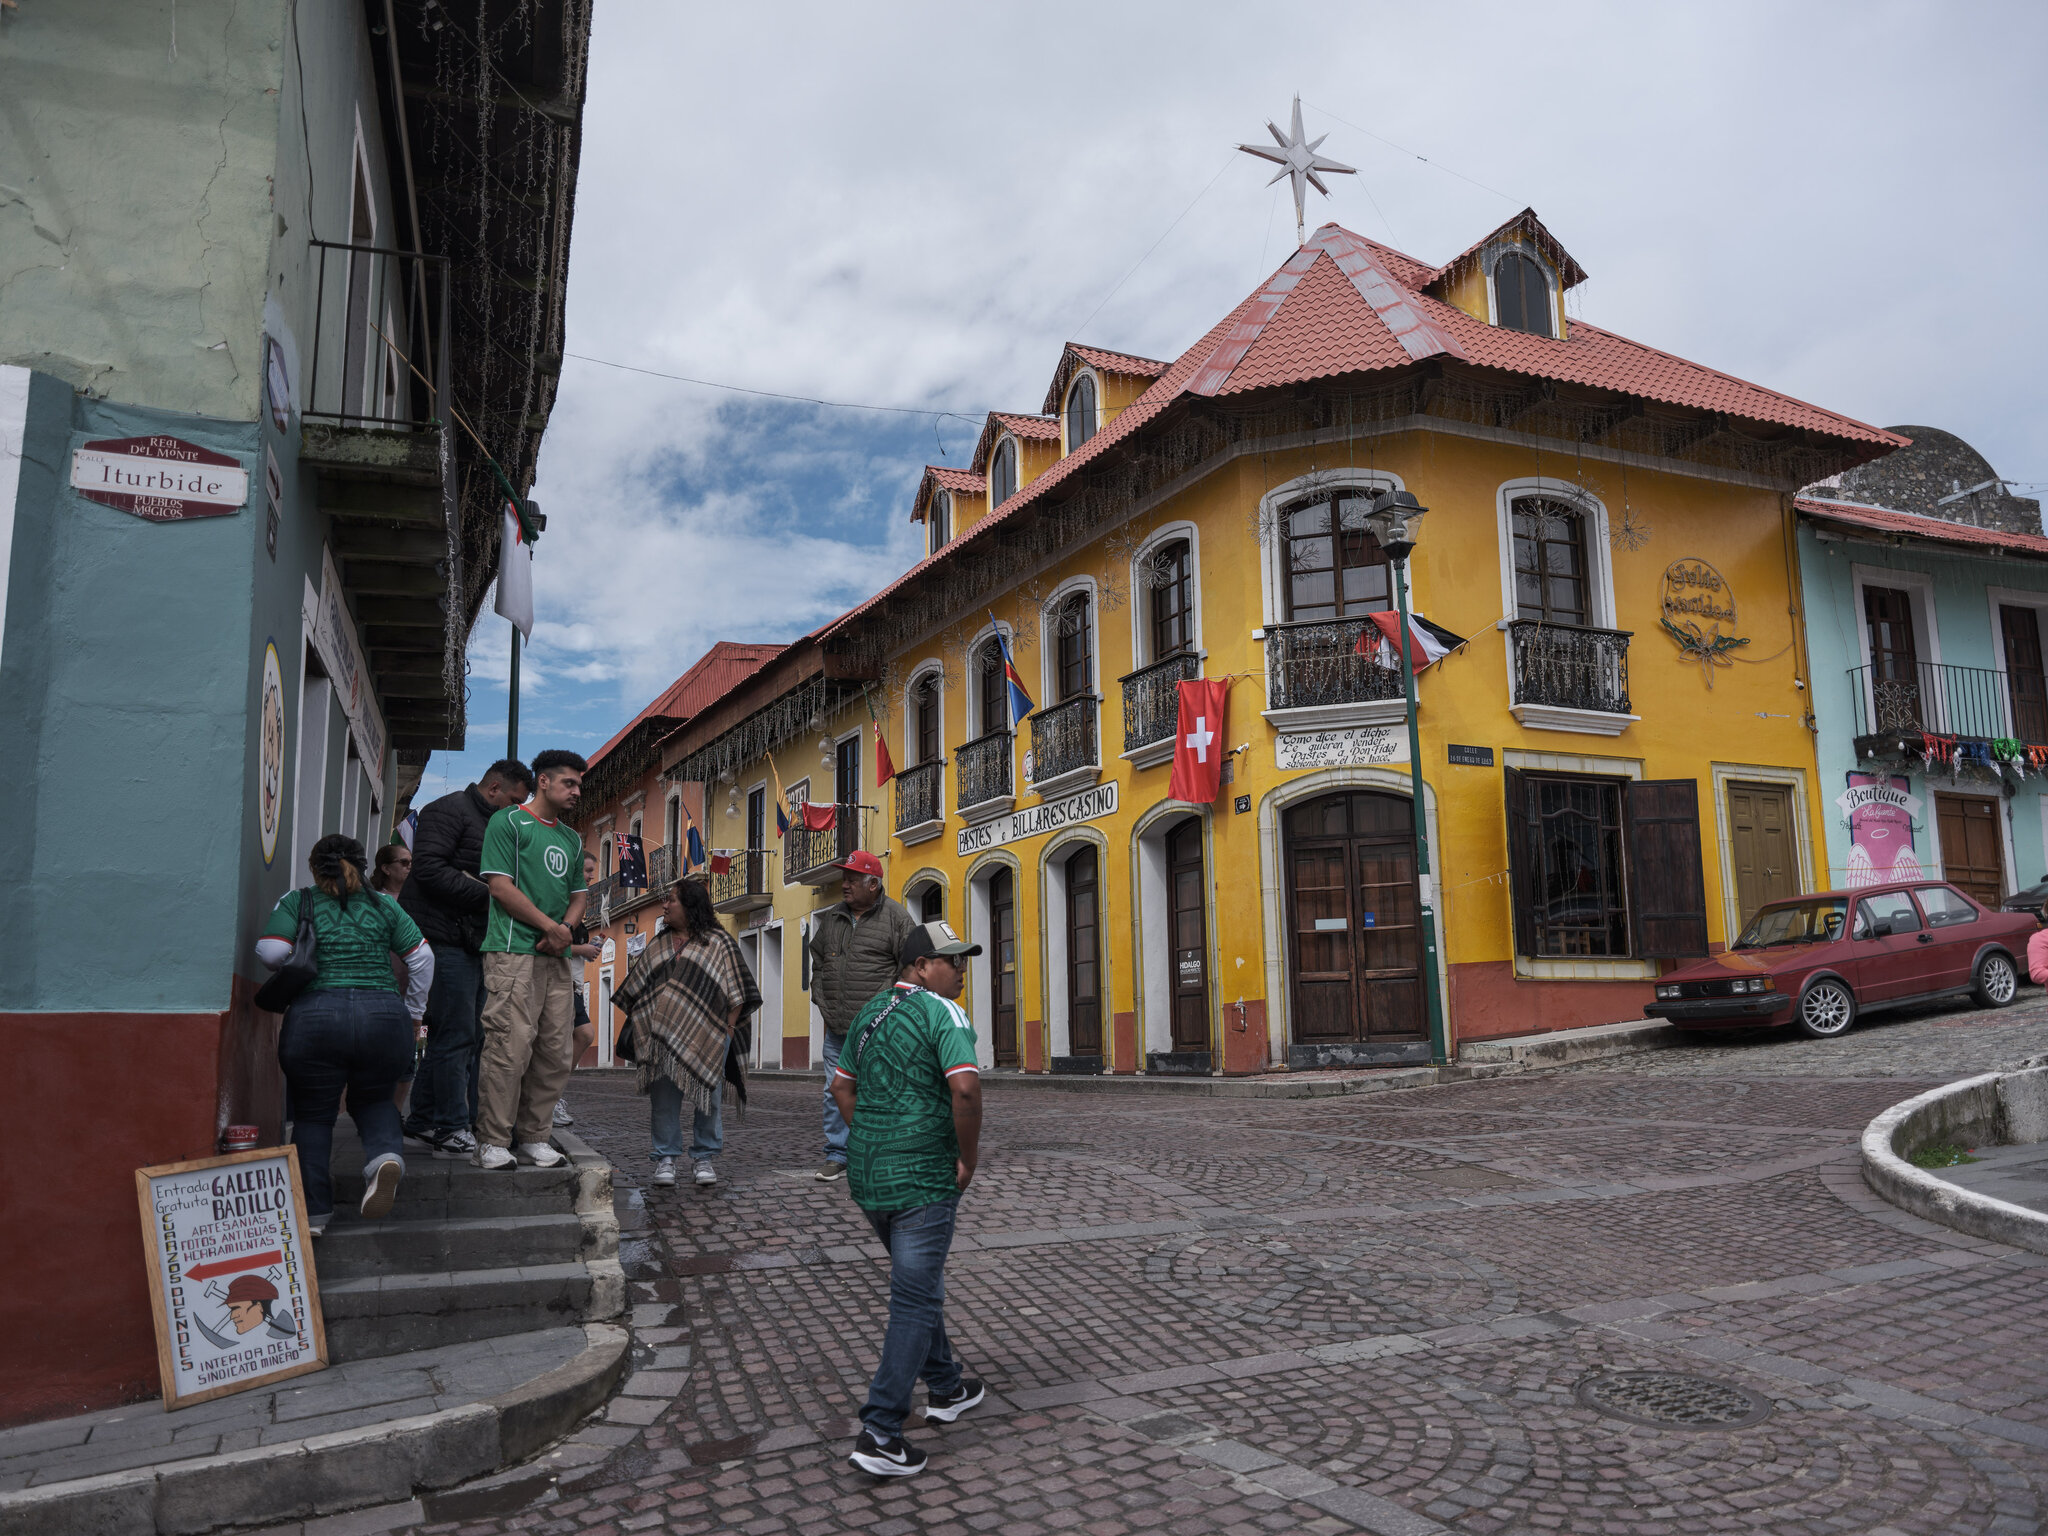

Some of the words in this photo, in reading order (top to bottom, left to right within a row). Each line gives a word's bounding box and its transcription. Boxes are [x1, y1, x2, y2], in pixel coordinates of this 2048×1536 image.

[80, 455, 105, 463] CALLE
[101, 465, 220, 495] Iturbide
[1281, 744, 1299, 754] Le
[1308, 742, 1344, 752] quieren
[1352, 737, 1386, 747] vender
[1315, 732, 1337, 743] dice
[1344, 730, 1355, 740] el
[1285, 759, 1321, 768] sabiendo
[1352, 755, 1365, 764] los
[1291, 751, 1328, 761] Pastes
[1350, 746, 1371, 756] Don
[1371, 743, 1398, 754] Fidel
[786, 784, 807, 812] OTEL
[1846, 785, 1908, 808] Boutique
[958, 824, 992, 853] PASTES
[1011, 801, 1067, 840] BILLARES
[1067, 786, 1115, 821] CASINO
[549, 851, 563, 871] 90
[1179, 960, 1201, 969] HIDALGO
[871, 998, 900, 1028] LACOSTE
[156, 1180, 210, 1199] Entrada
[212, 1166, 286, 1197] GALERIA
[155, 1195, 209, 1214] Gratuita
[212, 1188, 286, 1221] BADILLO
[181, 1237, 217, 1251] FOTOS
[222, 1224, 277, 1243] ANTIGUAS
[192, 1214, 267, 1237] ARTESANIAS
[162, 1213, 182, 1284] CUARZOS
[184, 1237, 275, 1262] HERRAMIENTAS
[278, 1209, 301, 1295] HISTORIA
[171, 1287, 194, 1372] DUENDES
[292, 1296, 309, 1351] ARTES
[198, 1361, 258, 1385] SINDICATO
[261, 1350, 300, 1368] MINERO
[200, 1347, 263, 1371] INTERIOR
[268, 1341, 292, 1354] DEL
